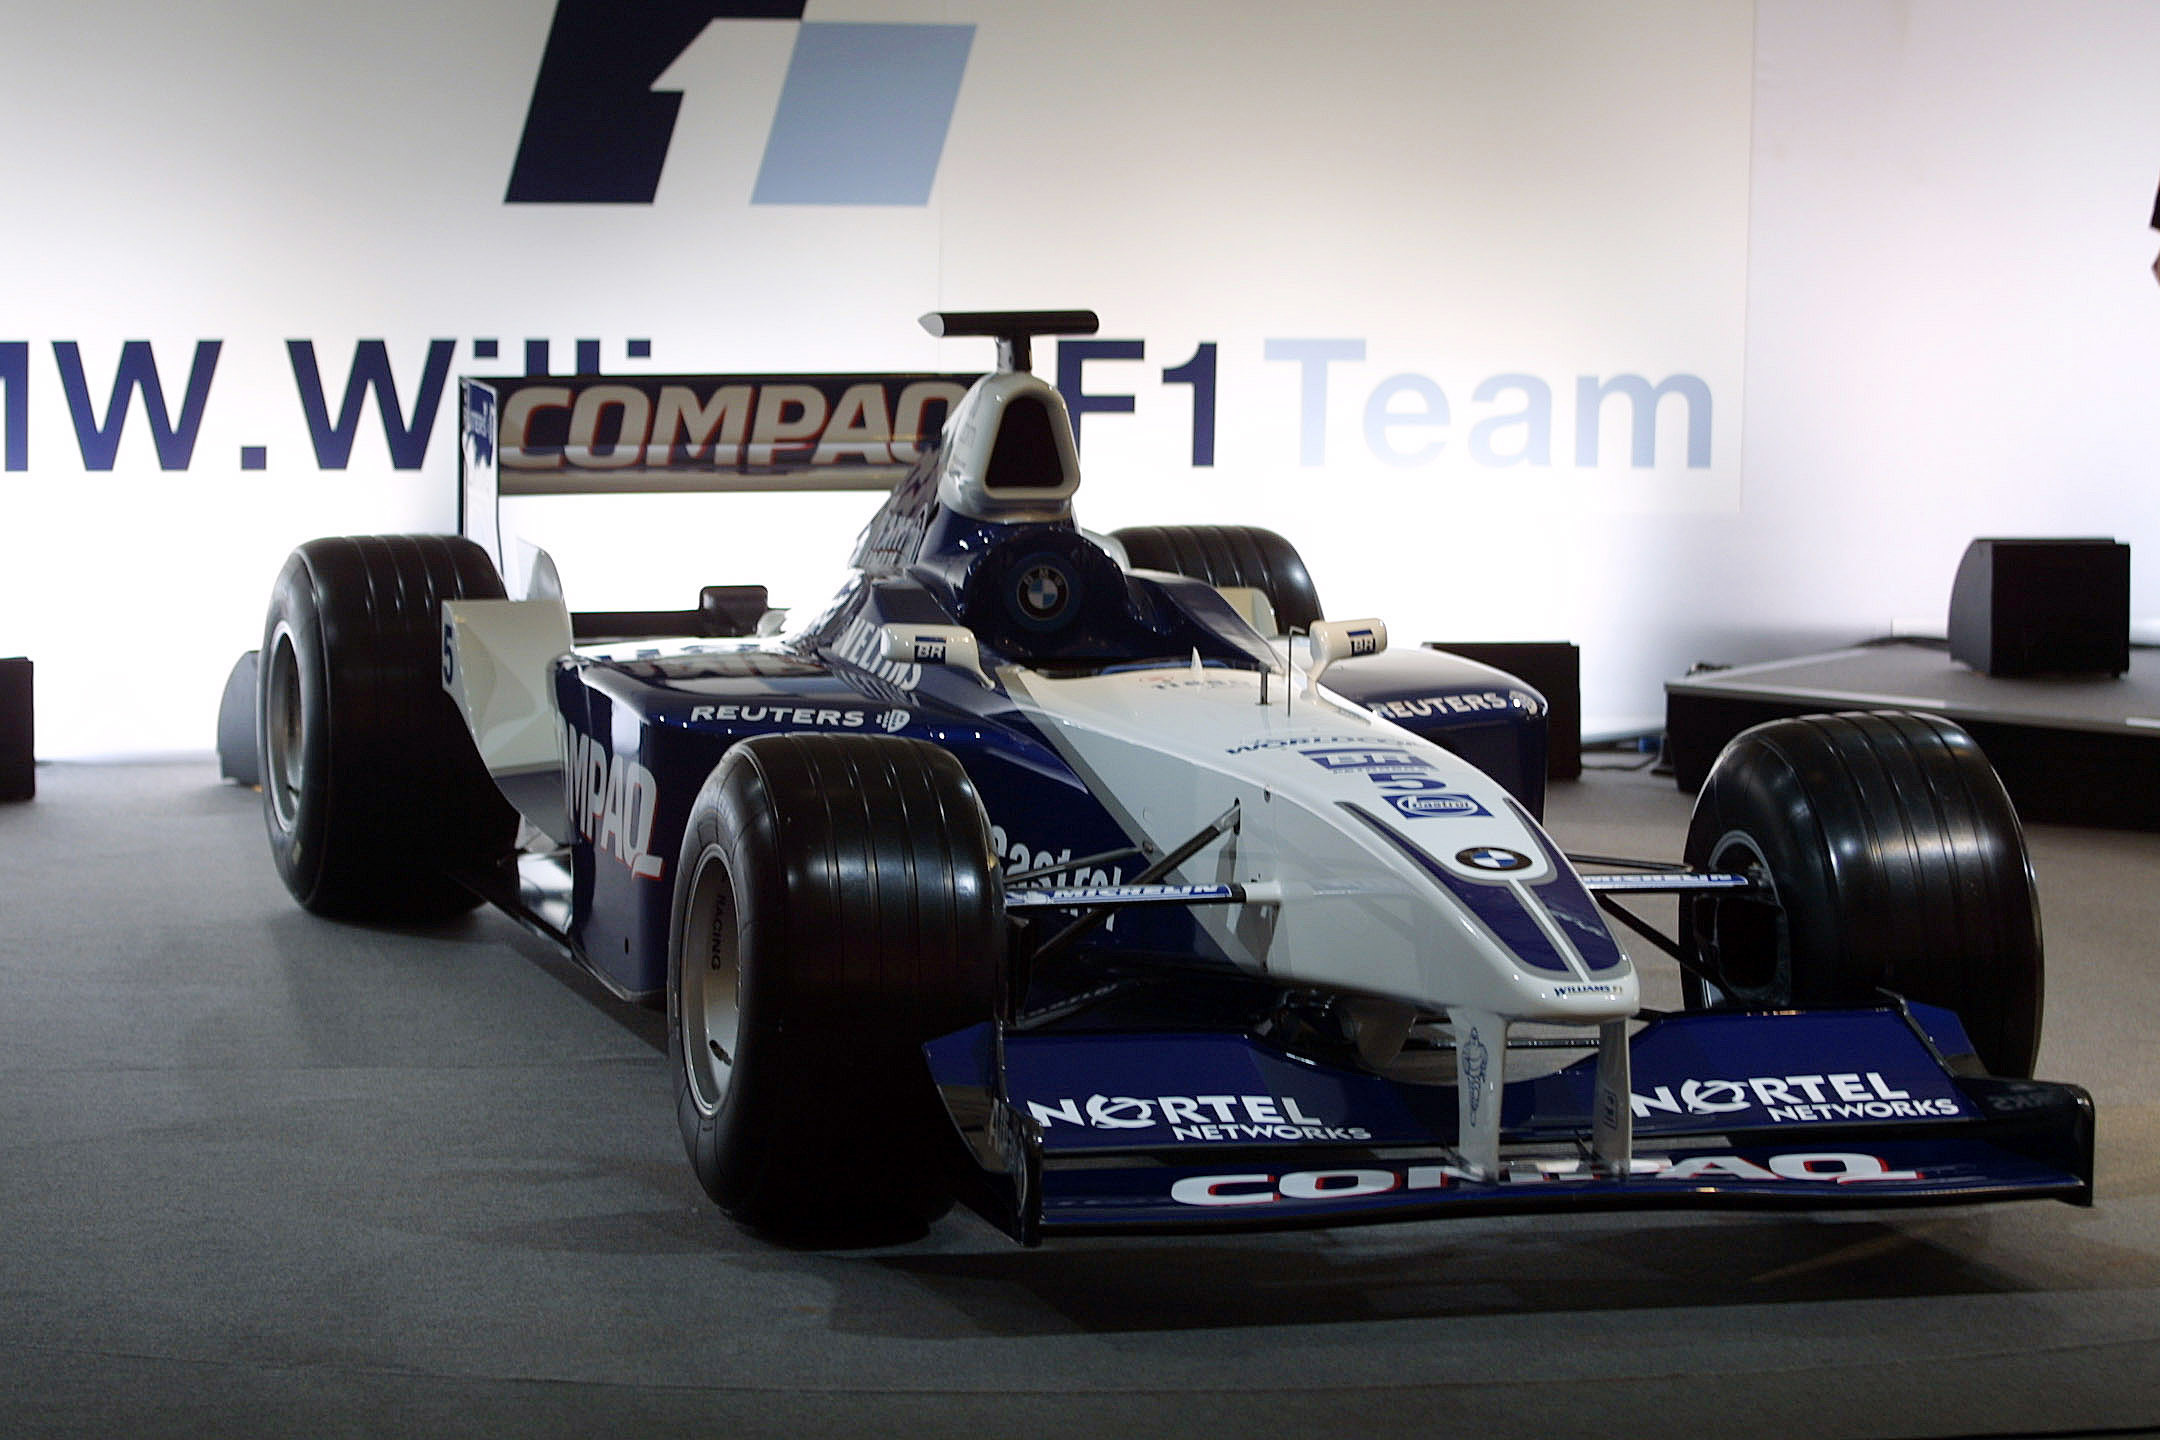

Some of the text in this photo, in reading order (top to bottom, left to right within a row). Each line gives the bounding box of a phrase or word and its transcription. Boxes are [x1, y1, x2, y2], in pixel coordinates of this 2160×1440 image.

[1264, 338, 1714, 470] Team
[443, 623, 454, 686] 5
[691, 705, 865, 728] REUTERS
[1368, 772, 1447, 791] 5
[711, 893, 727, 971] RACING
[1026, 1093, 1322, 1129] NORTEL
[1630, 1072, 1910, 1118] NORTEL
[1766, 1098, 1960, 1122] NETWORKS
[1171, 1124, 1372, 1141] NETWORKS
